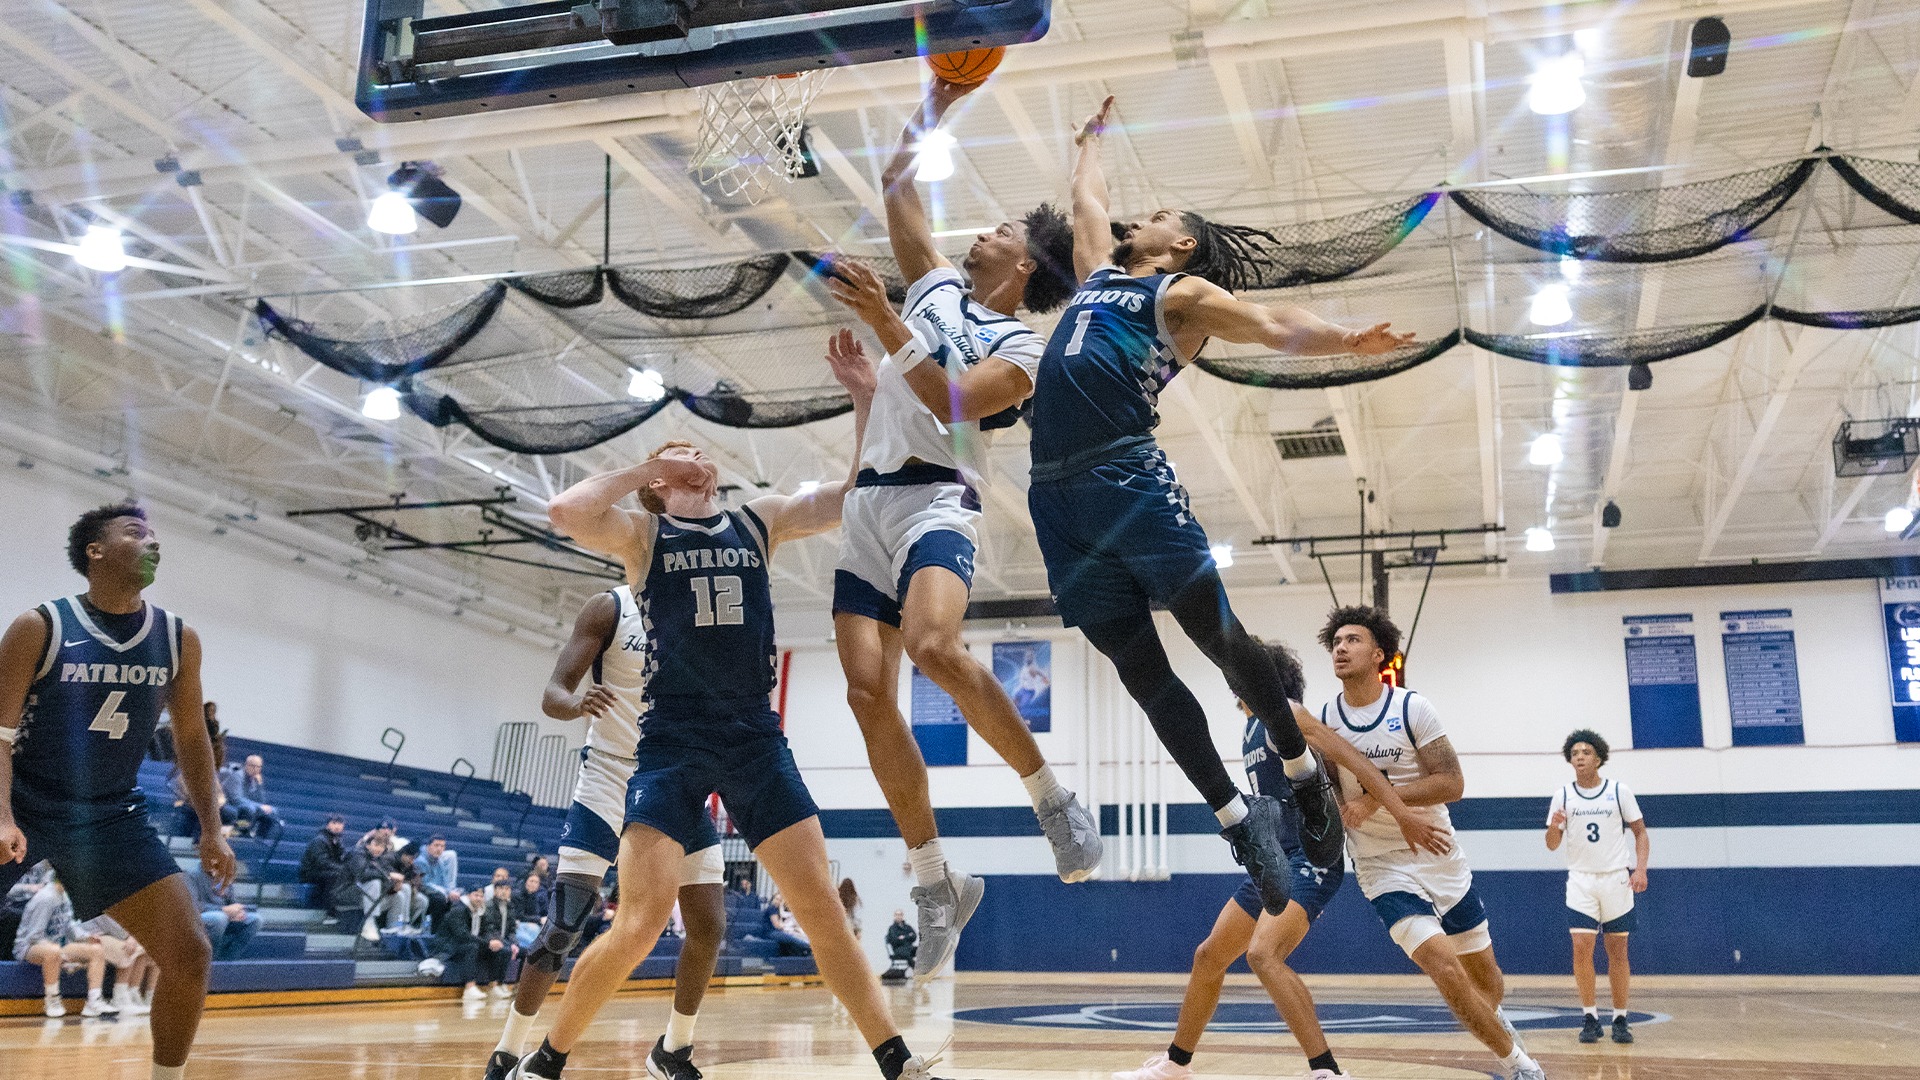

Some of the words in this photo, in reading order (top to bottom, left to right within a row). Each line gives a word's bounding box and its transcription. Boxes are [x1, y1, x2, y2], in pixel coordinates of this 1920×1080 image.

[1067, 290, 1146, 313] ATRIOTS
[1064, 310, 1094, 357] 1
[662, 547, 761, 573] PATRIOTS
[690, 575, 744, 627] 12
[60, 663, 169, 687] PATRIOTS
[87, 691, 130, 740] 4
[1364, 744, 1404, 763] isburg
[1586, 822, 1600, 843] 3
